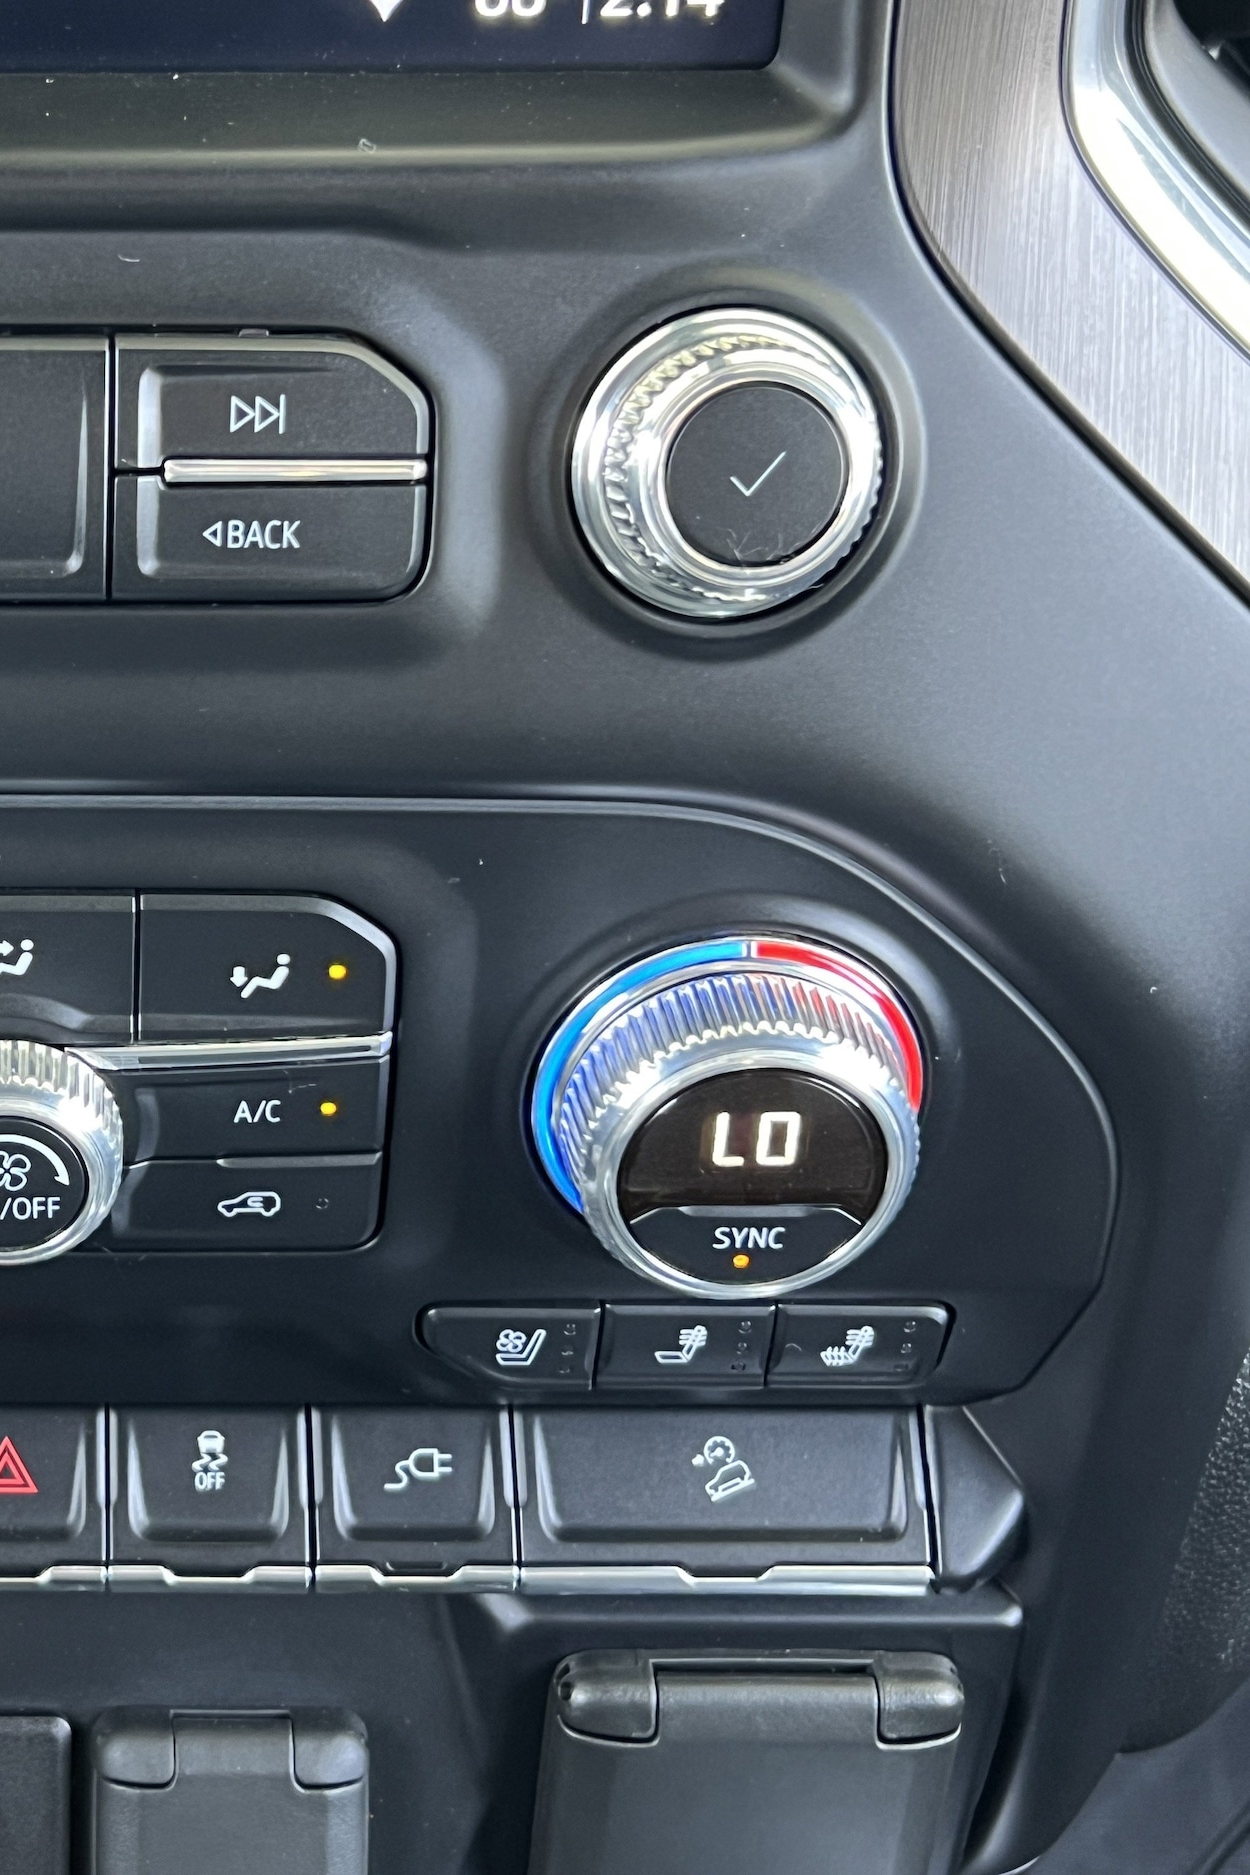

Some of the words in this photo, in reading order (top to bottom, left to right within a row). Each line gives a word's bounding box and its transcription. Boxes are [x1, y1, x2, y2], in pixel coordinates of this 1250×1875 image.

[227, 519, 301, 549] BACK
[233, 1099, 282, 1124] A/C
[712, 1226, 786, 1250] SYNC
[194, 1471, 226, 1491] OFF
